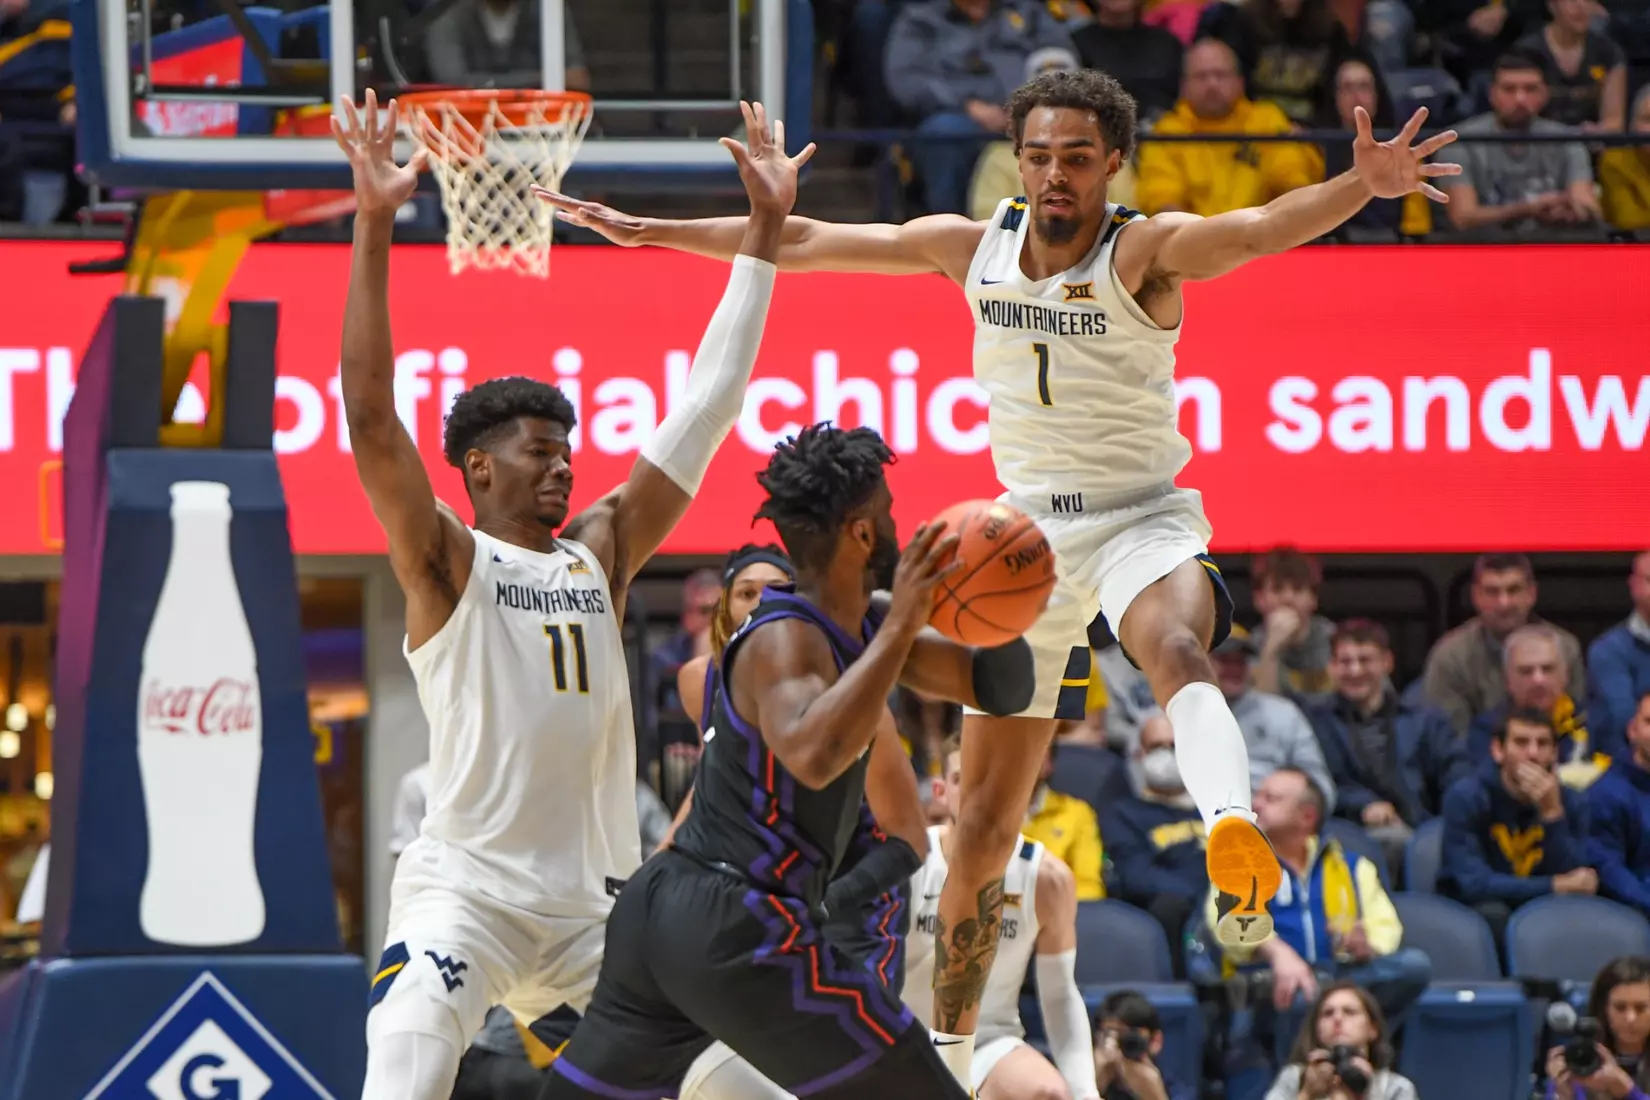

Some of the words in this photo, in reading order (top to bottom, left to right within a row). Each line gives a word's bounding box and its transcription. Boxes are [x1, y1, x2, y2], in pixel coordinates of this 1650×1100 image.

[979, 298, 1107, 336] MOUNTAINEERS
[1062, 282, 1097, 301] XII
[1032, 342, 1053, 406] 1
[733, 348, 1223, 453] chicn
[1052, 492, 1083, 513] WVU
[543, 623, 589, 694] 11
